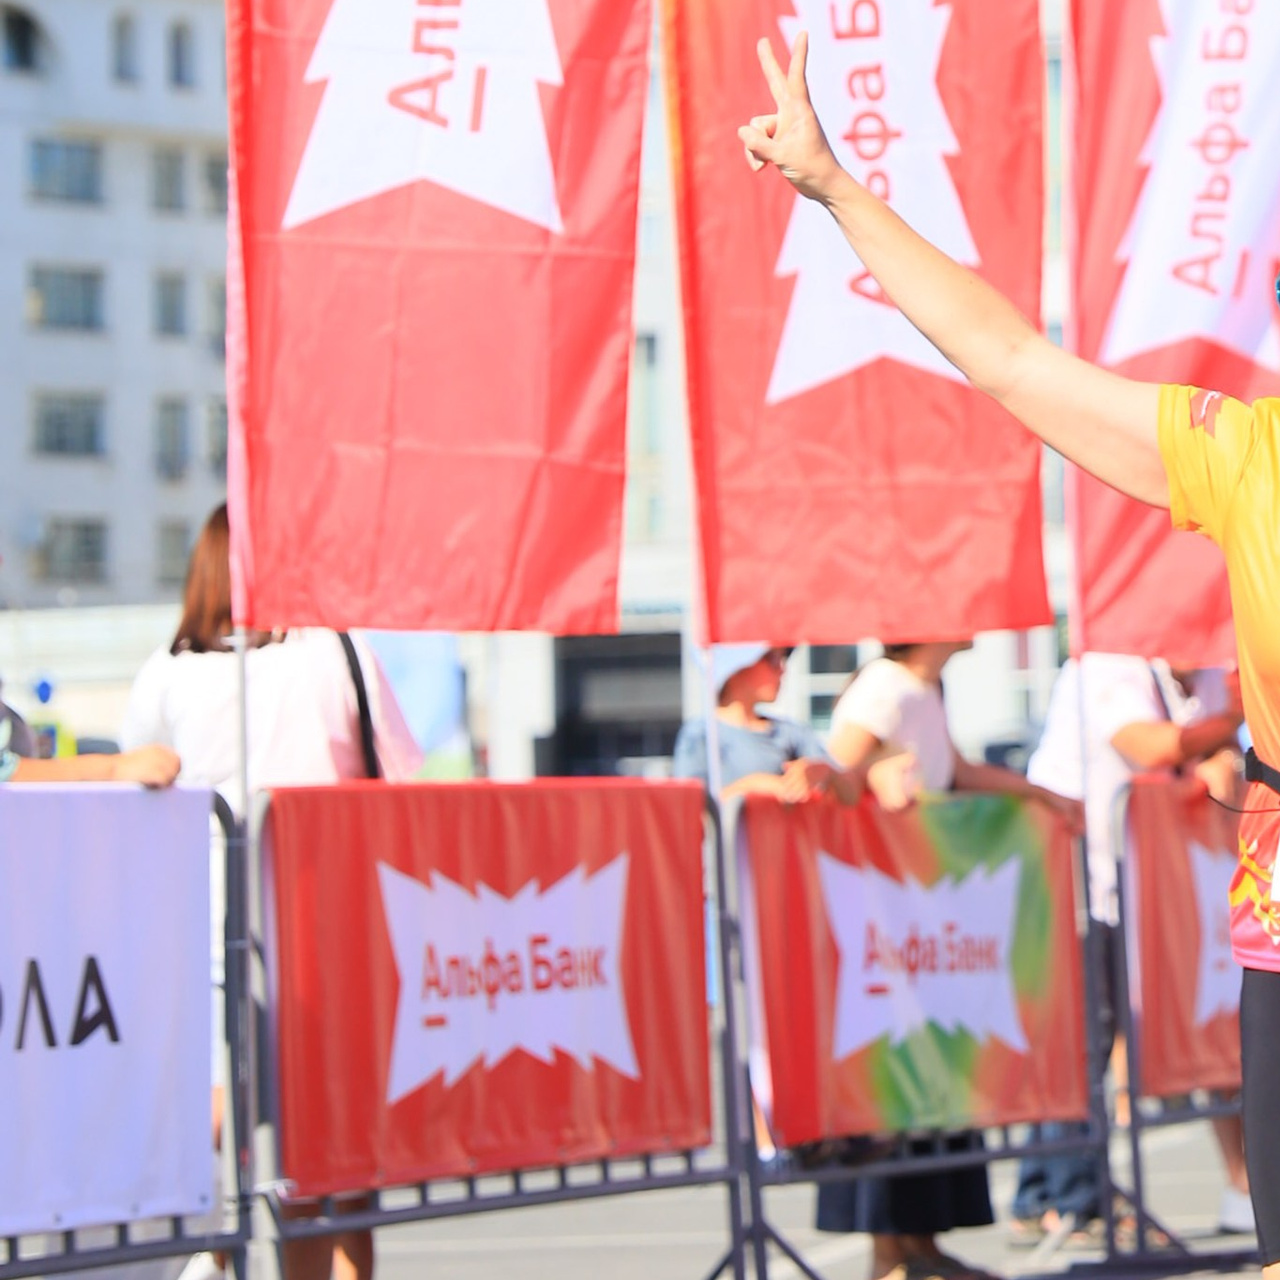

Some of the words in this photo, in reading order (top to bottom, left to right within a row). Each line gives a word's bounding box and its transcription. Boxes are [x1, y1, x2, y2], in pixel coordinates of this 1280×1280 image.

[840, 62, 903, 312] Аьфа
[1170, 83, 1251, 299] Альфа
[0, 956, 121, 1050] ЛА
[421, 939, 525, 1028] Альфа
[527, 933, 609, 994] Банк
